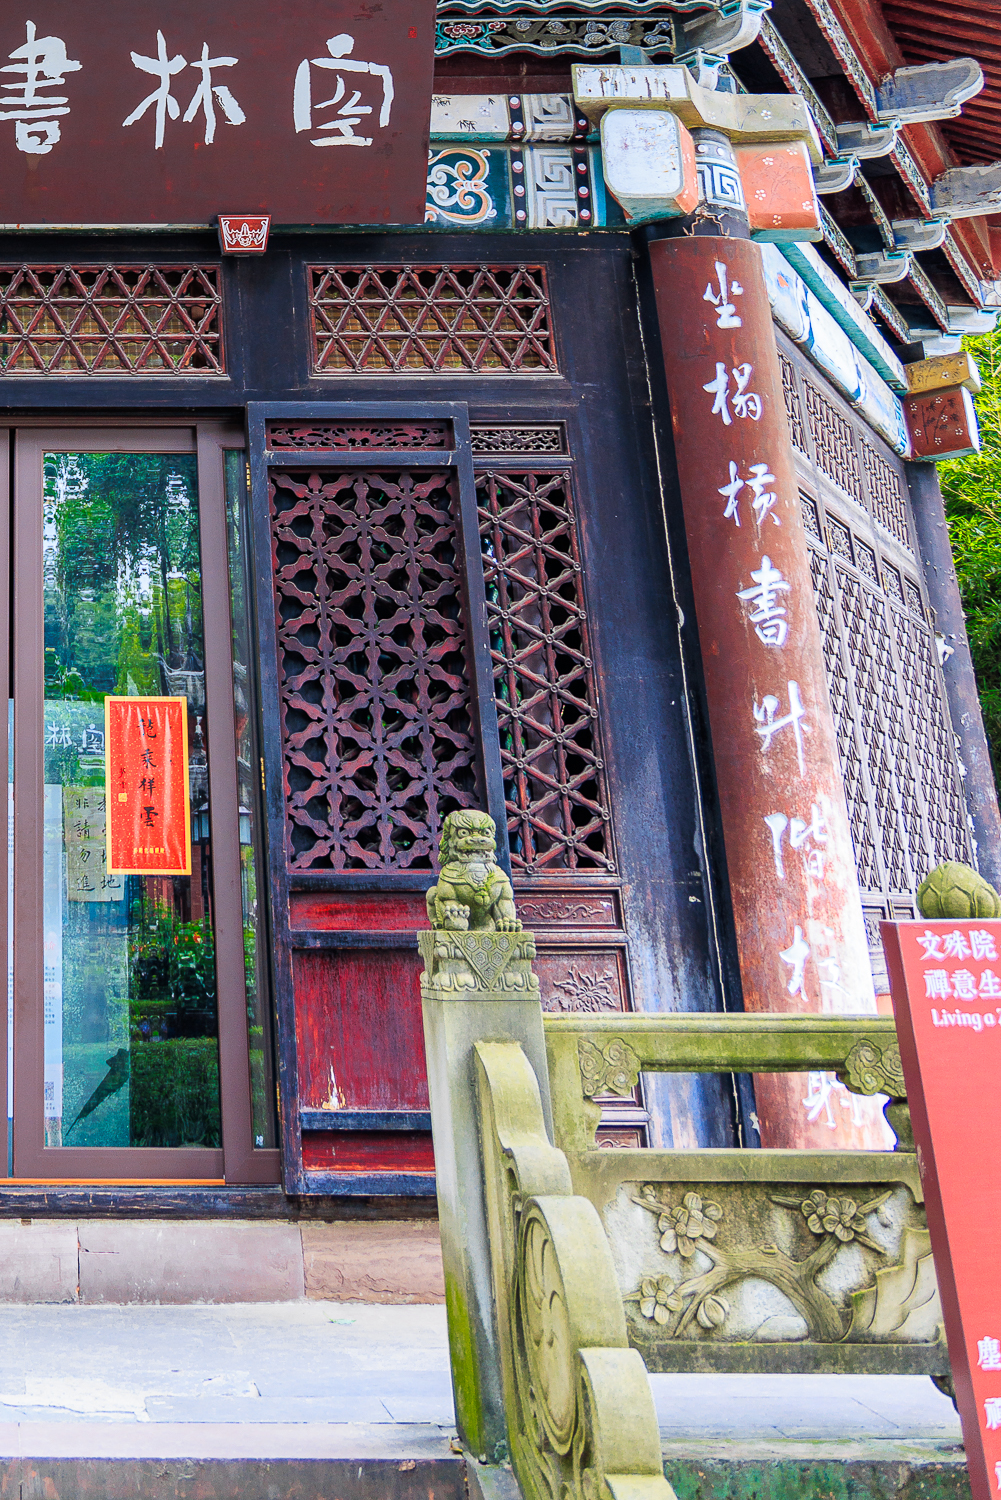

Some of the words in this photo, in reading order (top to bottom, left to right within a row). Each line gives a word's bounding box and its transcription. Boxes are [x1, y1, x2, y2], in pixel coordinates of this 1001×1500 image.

[916, 930, 998, 961] 文殊院
[923, 969, 1001, 1000] 禪意生
[931, 1008, 983, 1033] Living
[984, 1013, 996, 1026] a
